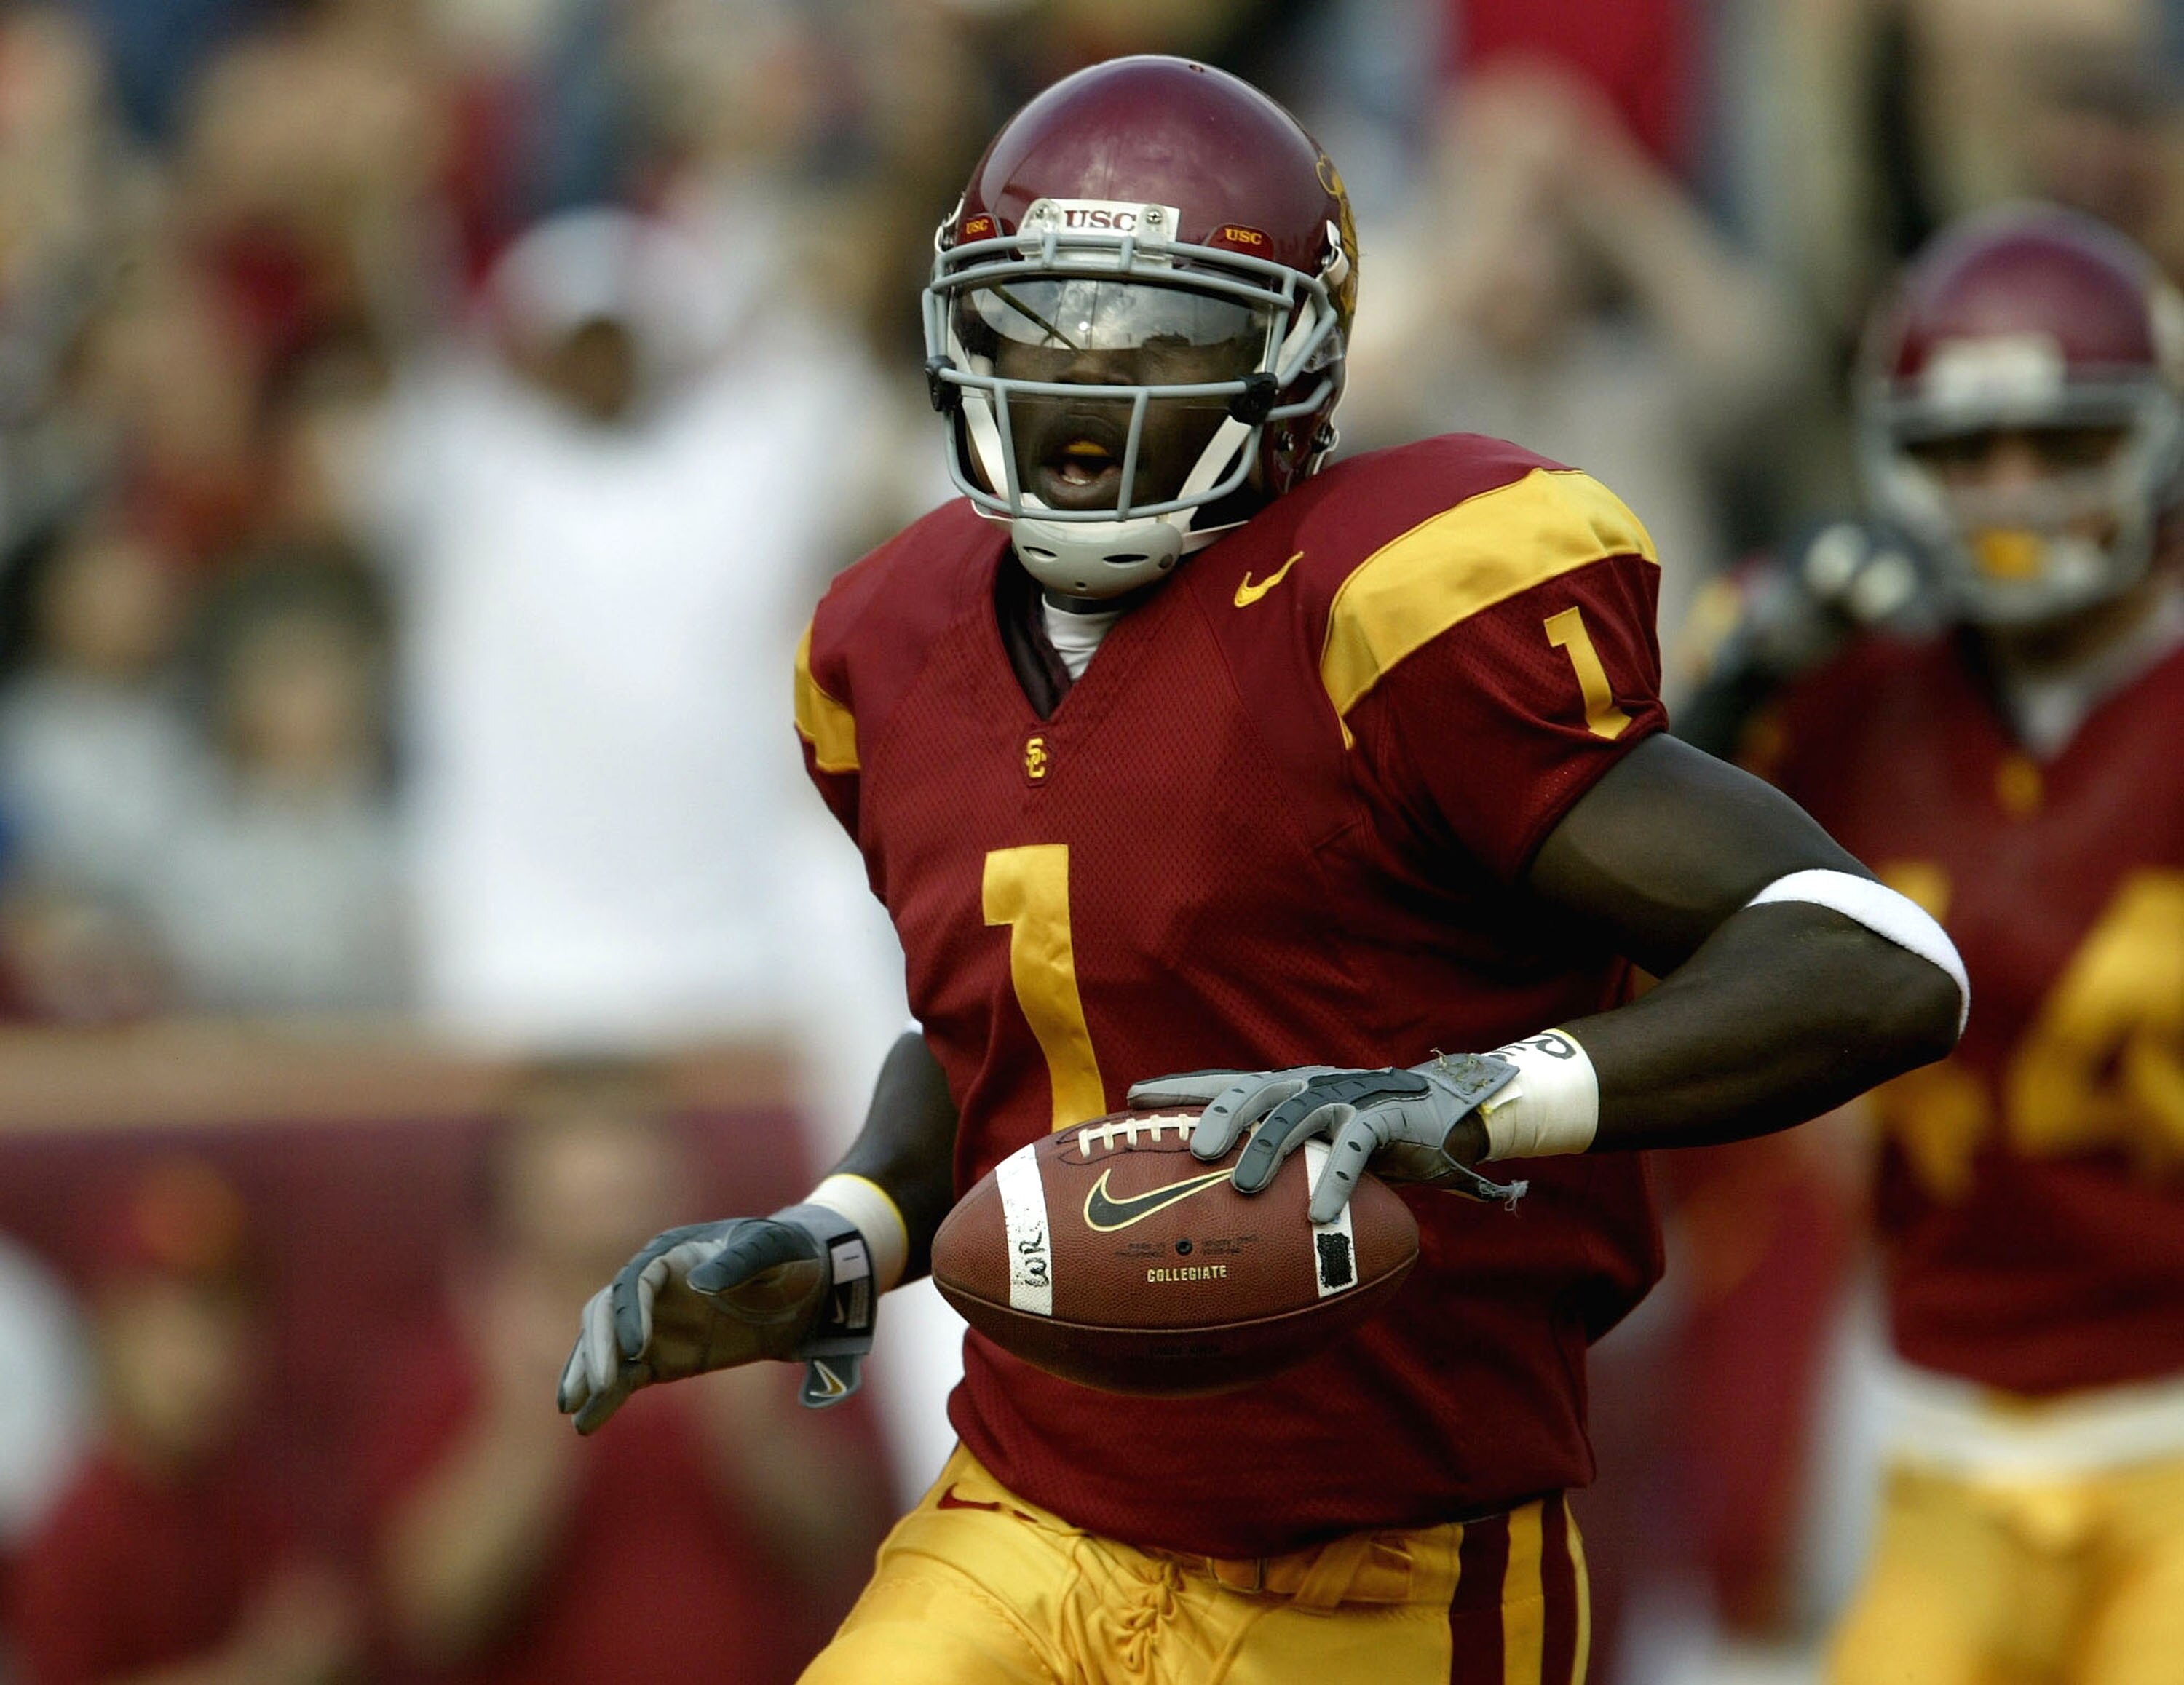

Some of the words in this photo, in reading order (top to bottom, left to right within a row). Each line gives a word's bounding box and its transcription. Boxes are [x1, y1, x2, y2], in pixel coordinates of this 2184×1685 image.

[966, 218, 989, 234] USC
[1064, 210, 1136, 231] USC
[1224, 228, 1262, 245] USC
[1543, 606, 1632, 740] 1
[982, 844, 1107, 1133] 1
[1147, 1265, 1227, 1282] COLLEGIATE
